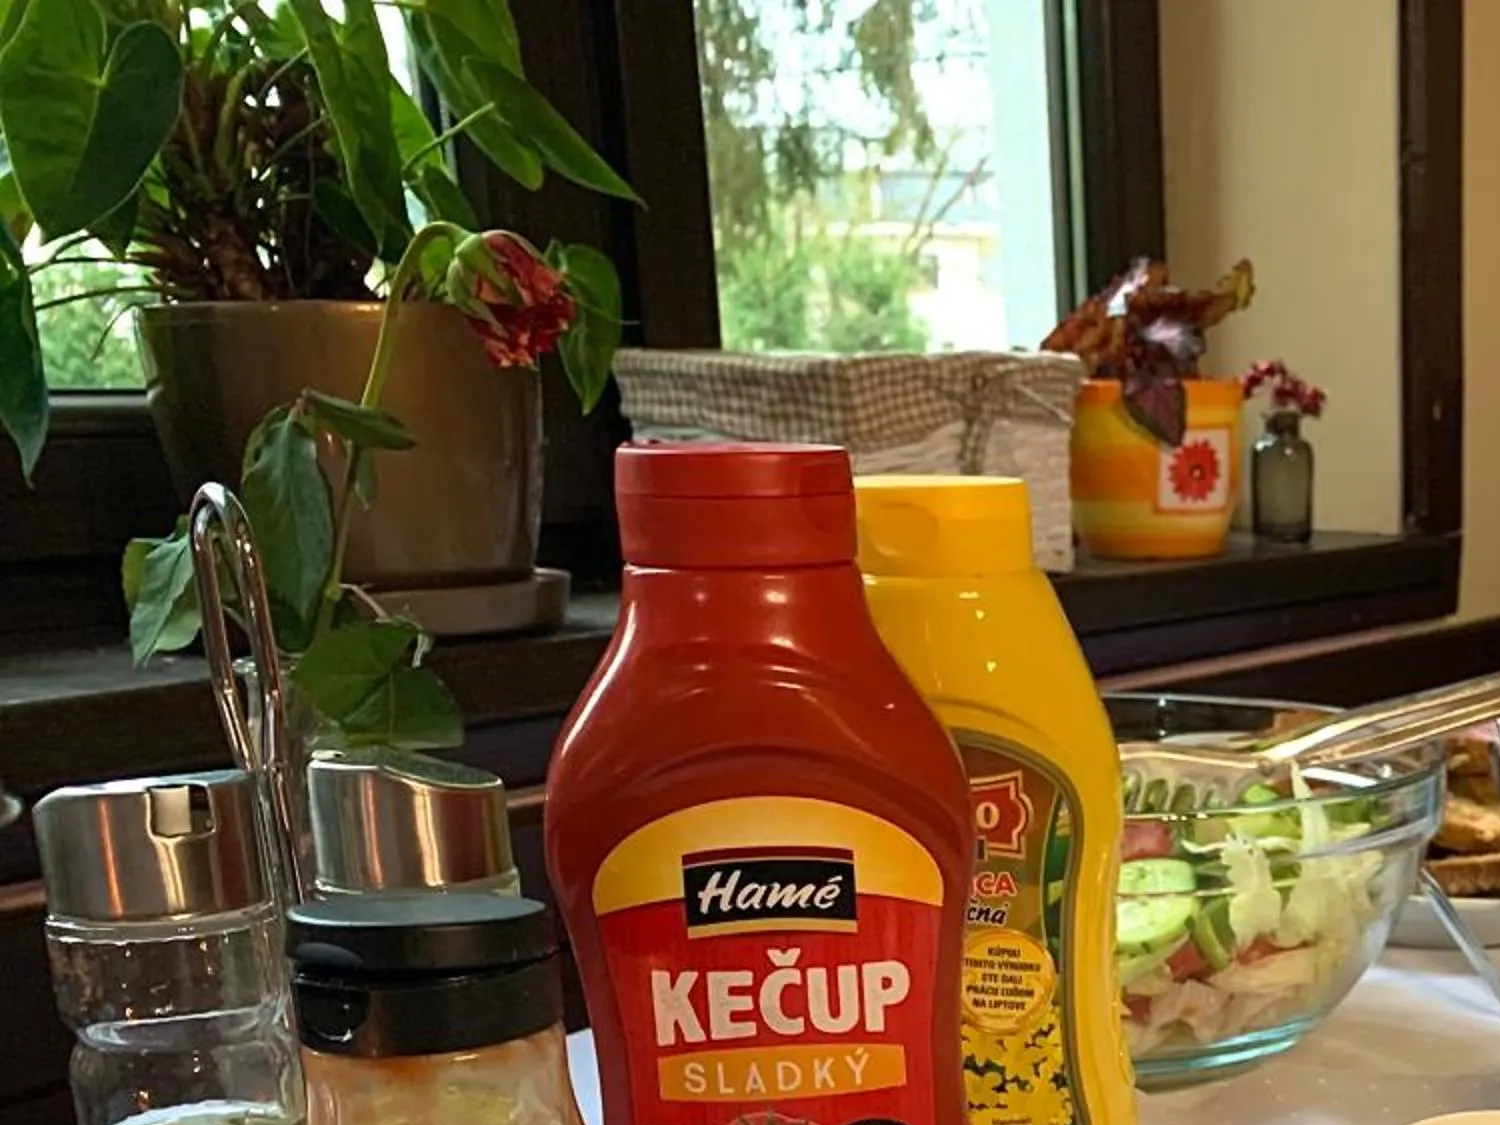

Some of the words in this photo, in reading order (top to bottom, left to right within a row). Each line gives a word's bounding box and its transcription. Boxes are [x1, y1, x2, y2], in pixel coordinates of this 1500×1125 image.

[697, 869, 843, 915] Hamé
[651, 948, 911, 1047] KEČUP
[683, 1047, 870, 1095] SLADKÝ
